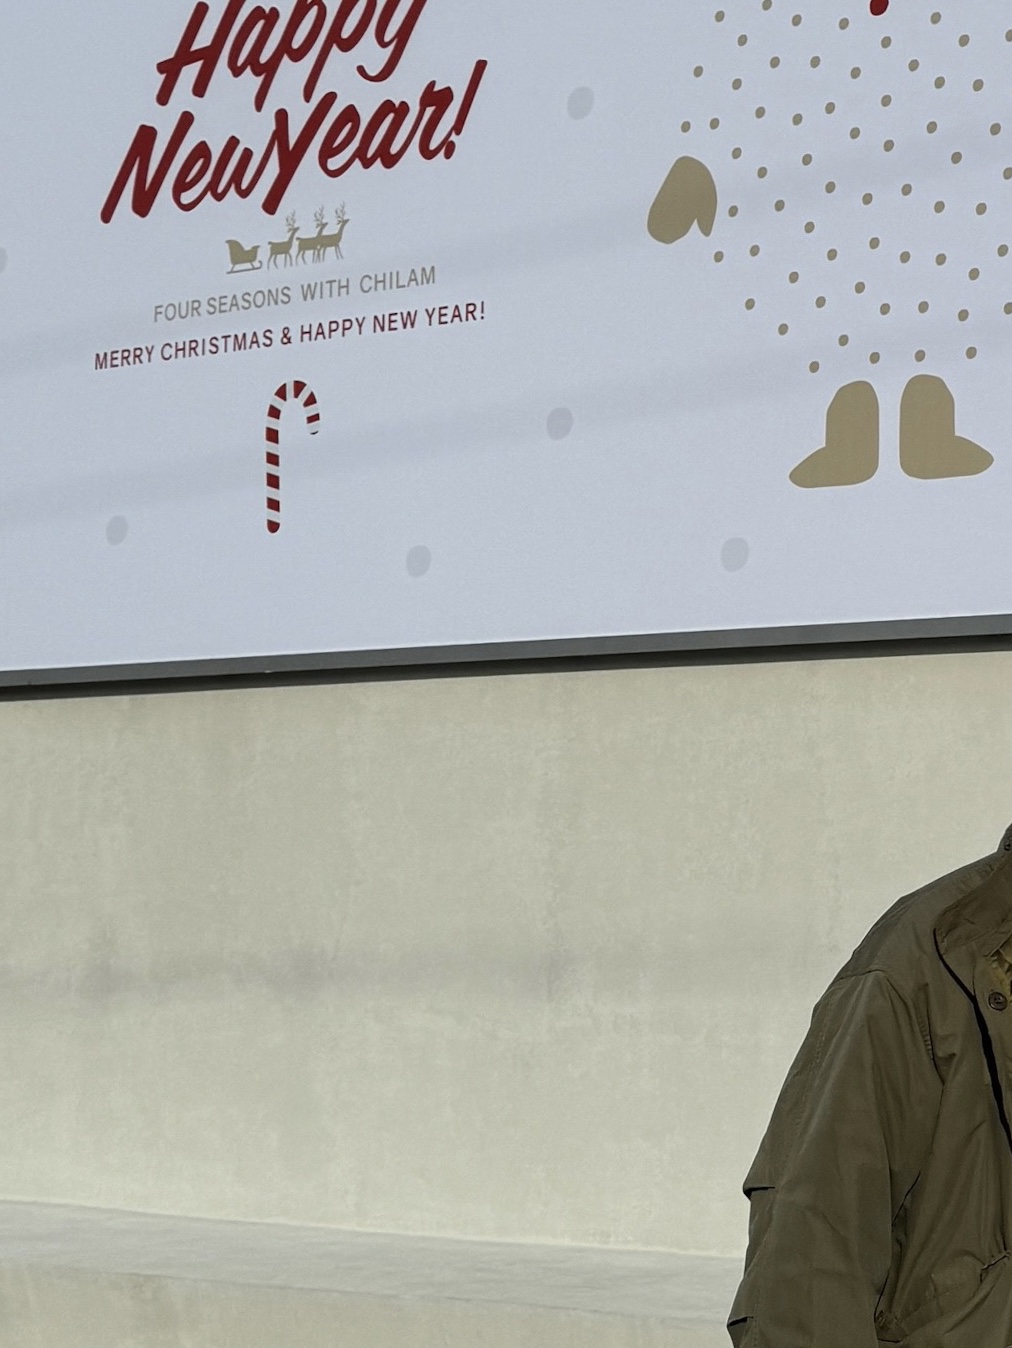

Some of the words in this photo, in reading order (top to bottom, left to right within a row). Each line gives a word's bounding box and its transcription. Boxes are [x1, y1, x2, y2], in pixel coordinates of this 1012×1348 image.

[155, 0, 428, 112] Happy
[153, 299, 202, 323] FOUR
[206, 286, 292, 315] SEASONS
[301, 278, 350, 301] WITH
[359, 265, 436, 293] CHILAM
[94, 345, 155, 370] MERRY
[160, 328, 274, 361] CHRISTMAS
[280, 326, 292, 345] &
[300, 316, 366, 343] HAPPY
[373, 309, 418, 334] NEW
[425, 300, 485, 327] YEAR!
